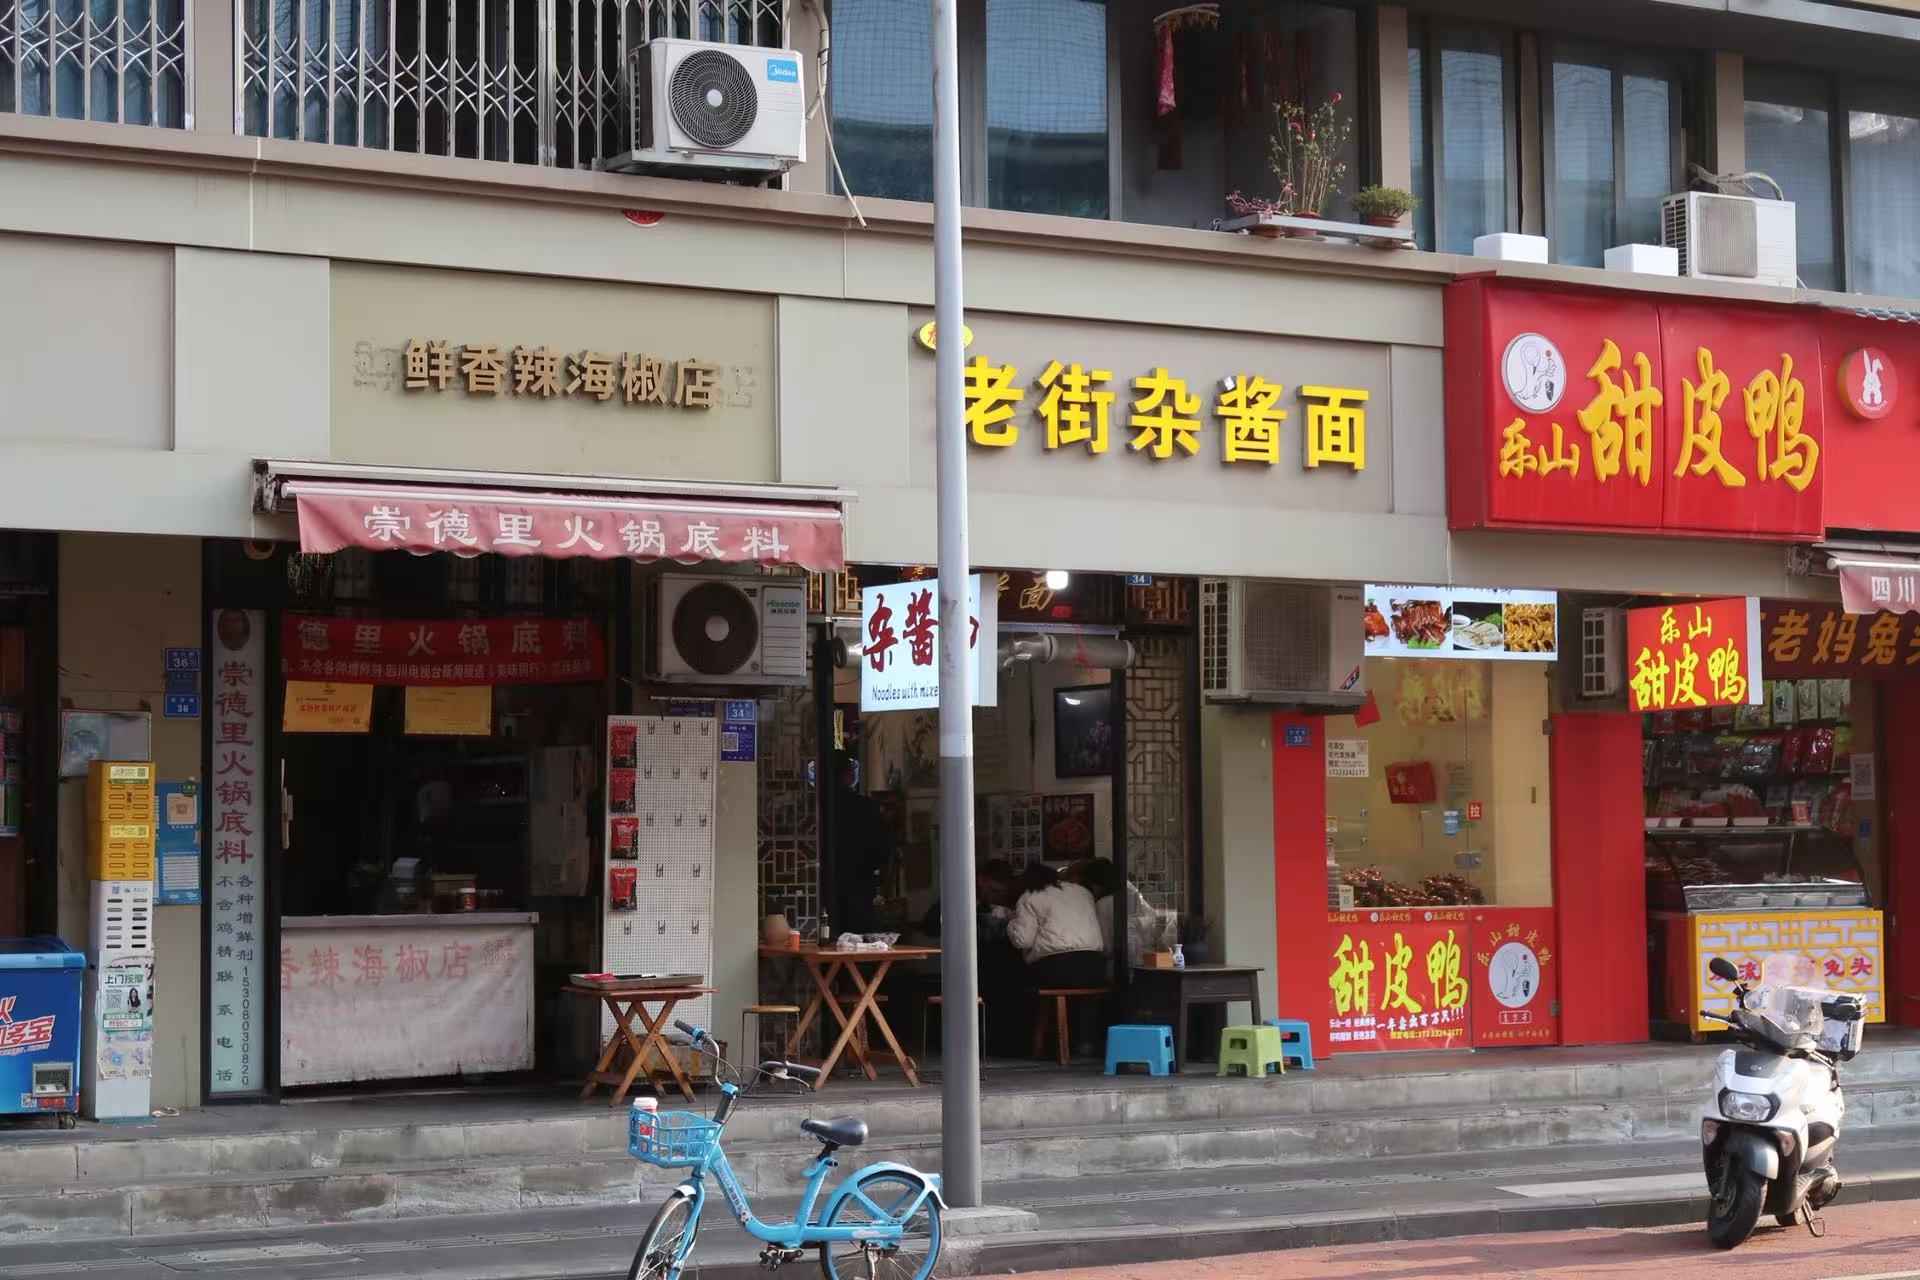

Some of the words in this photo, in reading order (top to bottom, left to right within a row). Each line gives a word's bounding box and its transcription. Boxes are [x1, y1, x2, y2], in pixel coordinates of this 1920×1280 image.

[403, 338, 720, 409] 鲜香辣海椒店
[964, 355, 1369, 471] 老街杂酱面
[1500, 417, 1580, 479] 乐山
[1577, 337, 1820, 493] 甜皮鸭
[364, 505, 789, 560] 崇德里火锅底料
[1132, 575, 1145, 584] 34
[1872, 576, 1915, 604] 四川
[297, 619, 589, 656] 德里火锅底料
[863, 588, 979, 673] 杂酱
[1660, 603, 1713, 645] 乐山
[872, 681, 900, 701] Noodles
[902, 681, 918, 699] with
[919, 682, 939, 699] mixe
[1629, 637, 1748, 711] 甜皮鸭
[731, 708, 745, 718] 34
[215, 660, 255, 865] 崇德里火锅底料
[104, 973, 144, 985] 上门按摩
[1329, 930, 1469, 1017] 甜皮鸭
[1709, 955, 1873, 981] 流兔头
[0, 1014, 56, 1047] 多宝
